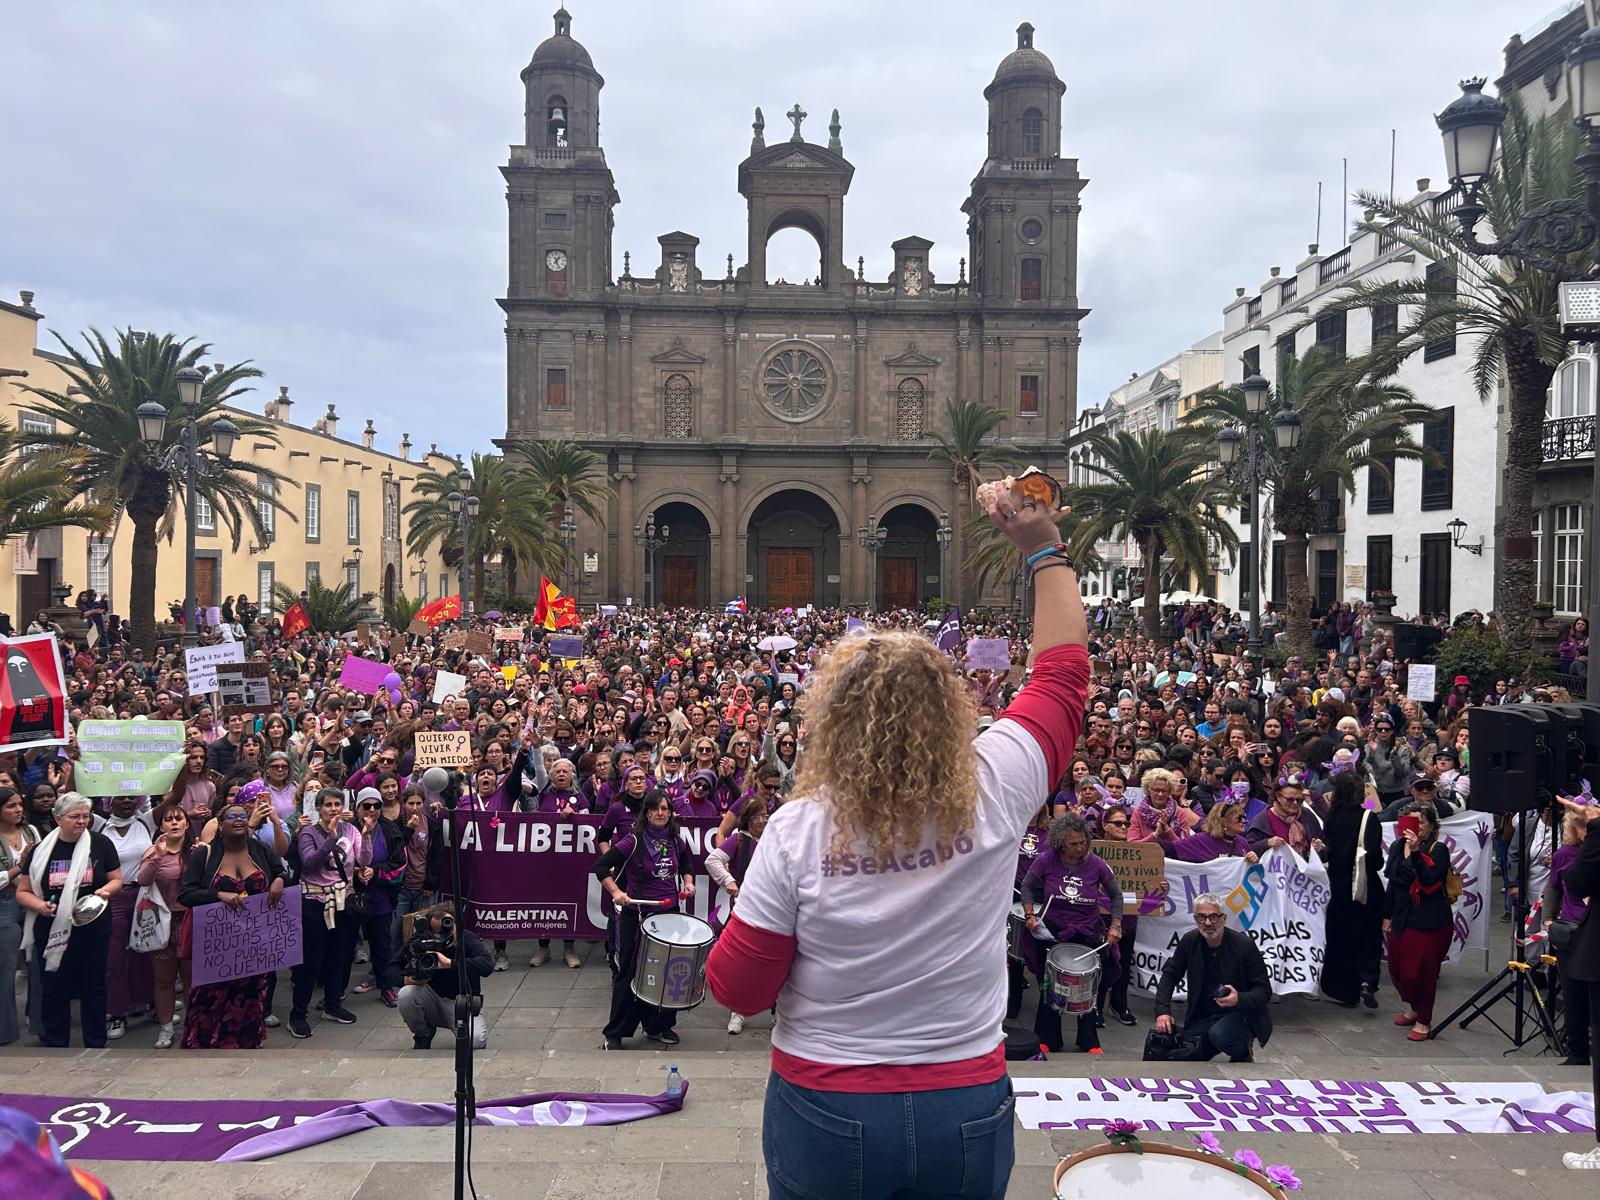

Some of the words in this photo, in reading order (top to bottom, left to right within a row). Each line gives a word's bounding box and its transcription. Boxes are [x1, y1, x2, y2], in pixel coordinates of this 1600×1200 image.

[418, 733, 455, 742] QUIERO
[421, 744, 451, 753] VIVIR
[420, 756, 437, 764] SIN
[440, 755, 468, 764] MIEDO
[496, 823, 618, 854] LIBER
[1113, 866, 1131, 877] DAS
[1120, 881, 1147, 891] BRES
[260, 892, 287, 915] LS
[475, 909, 569, 921] VALENTINA
[204, 918, 242, 939] HIJAS
[246, 914, 262, 931] DE
[266, 909, 289, 927] LAS
[475, 920, 519, 930] Asociación
[534, 922, 567, 930] mujeres
[203, 929, 262, 955] BRUJAS
[269, 918, 299, 940] QUE
[204, 954, 226, 969] NO
[234, 933, 297, 962] PUDISTEIS
[218, 951, 286, 978] QUEMAR
